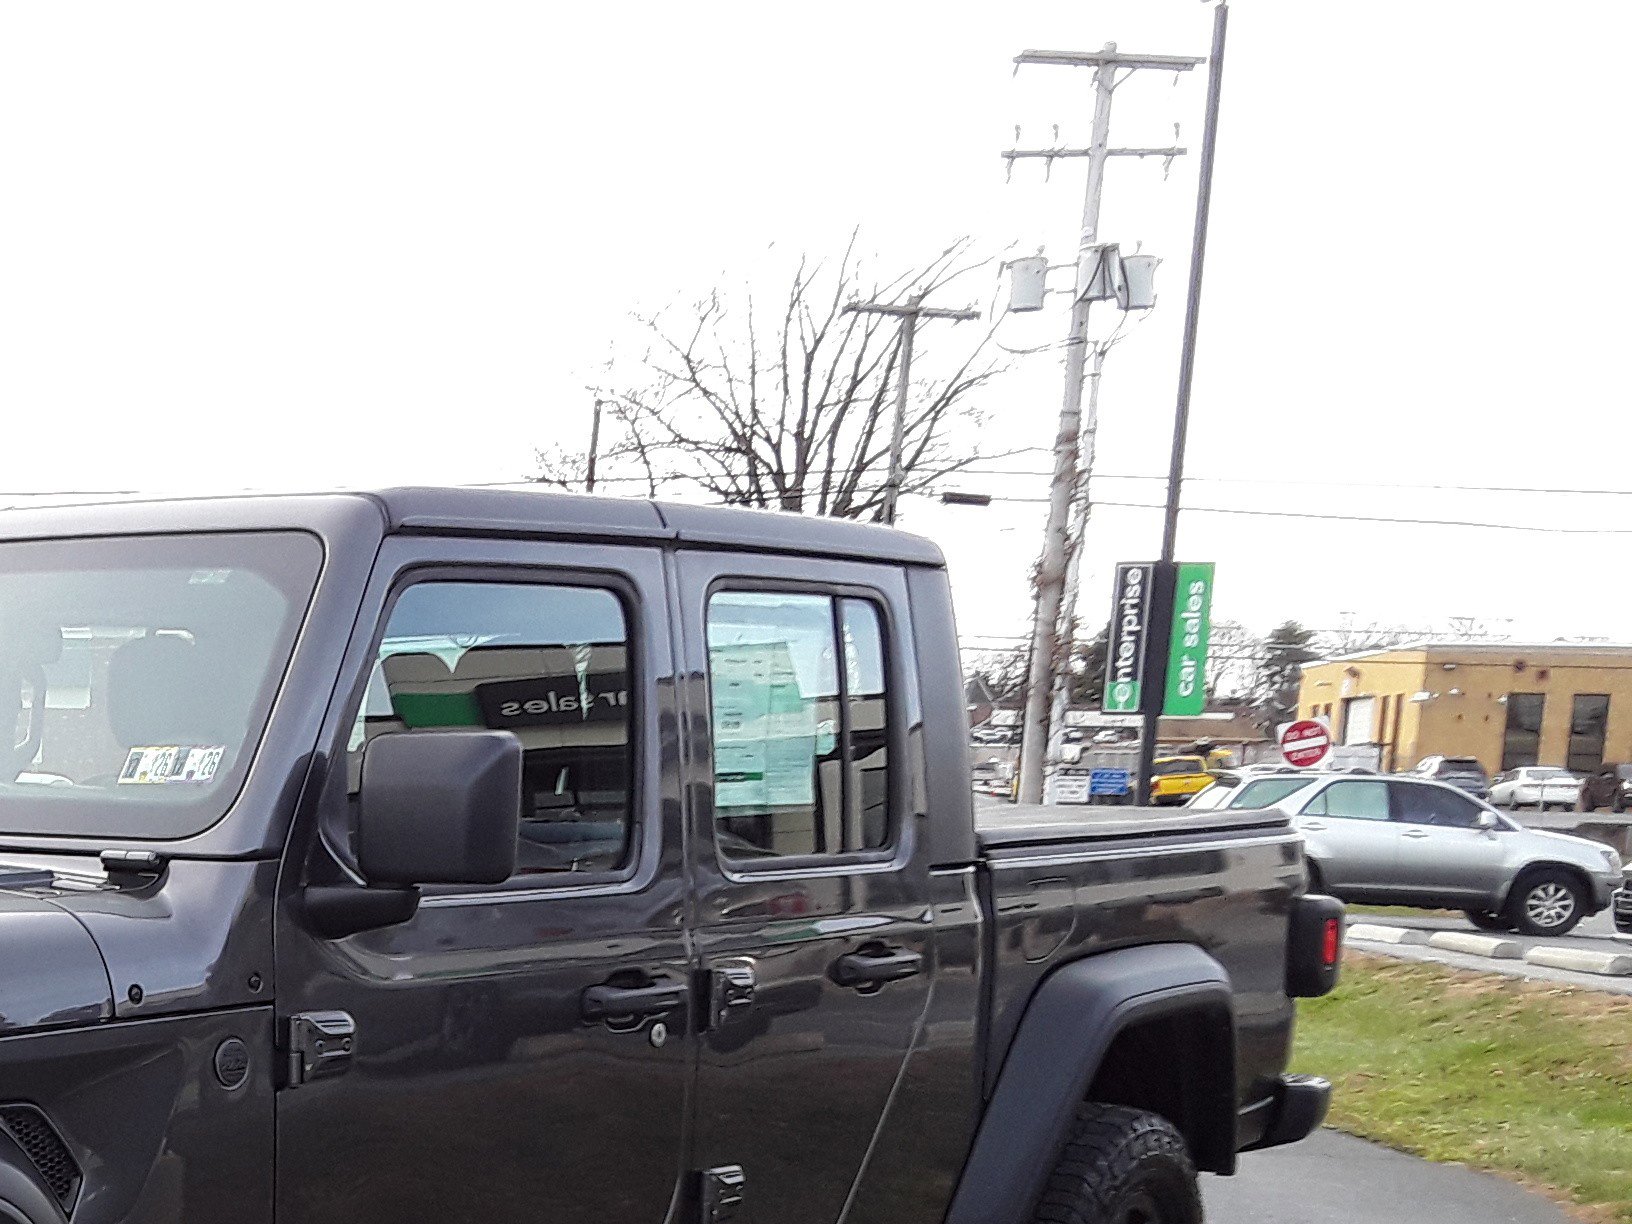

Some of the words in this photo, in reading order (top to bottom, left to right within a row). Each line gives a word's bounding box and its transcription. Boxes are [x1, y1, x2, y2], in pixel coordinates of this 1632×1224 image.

[1114, 567, 1142, 706] enterprise
[1181, 580, 1205, 648] sales
[1178, 654, 1197, 697] car
